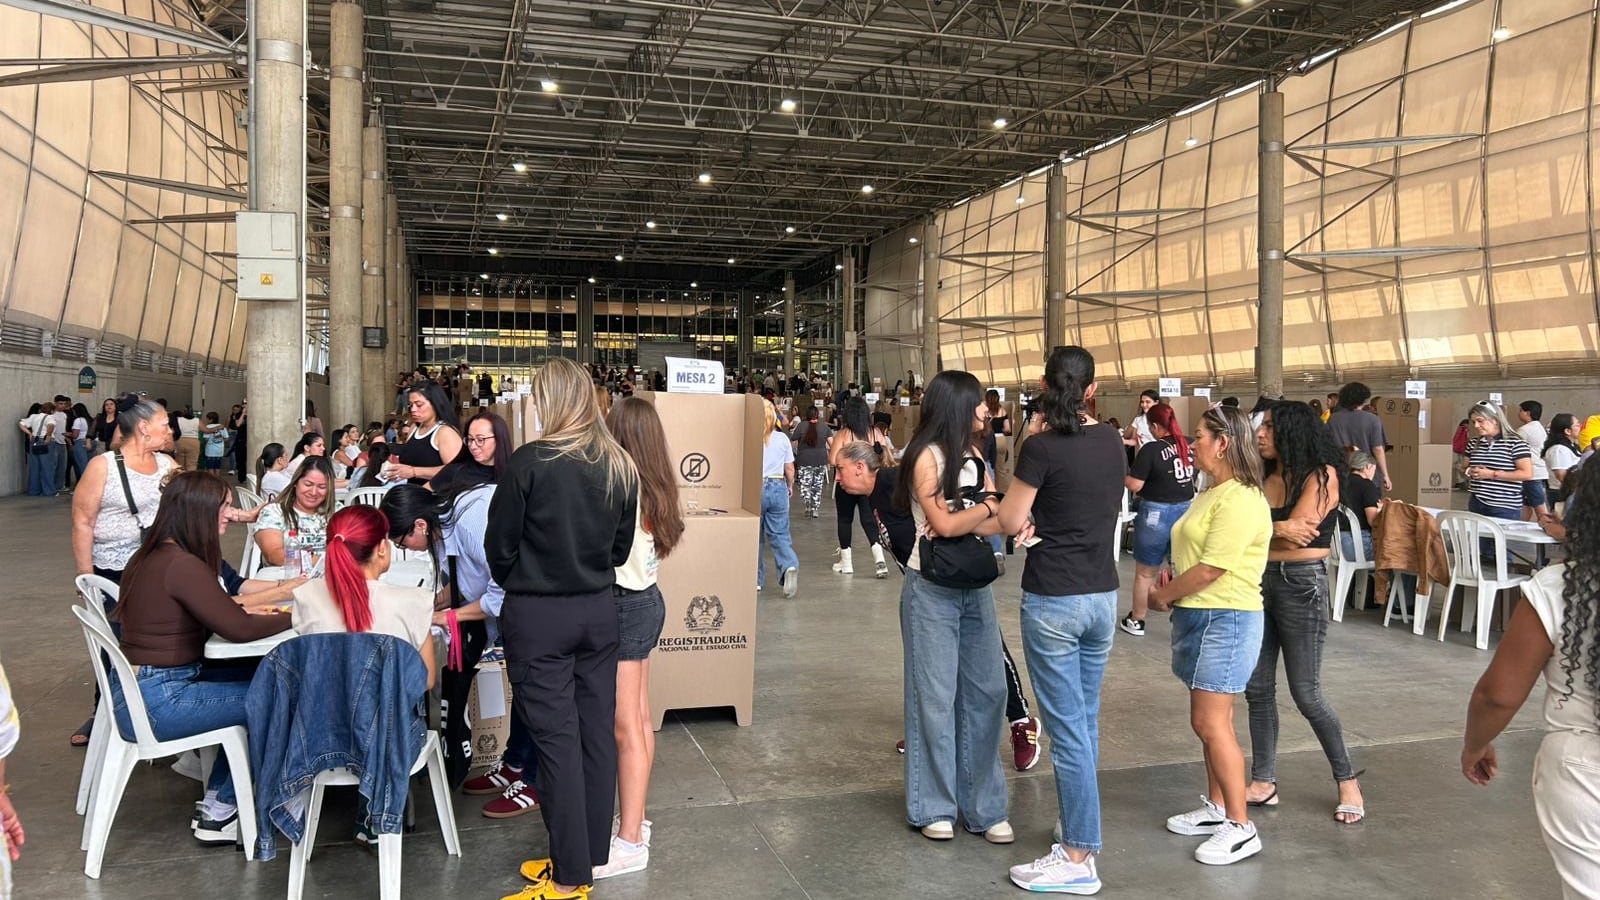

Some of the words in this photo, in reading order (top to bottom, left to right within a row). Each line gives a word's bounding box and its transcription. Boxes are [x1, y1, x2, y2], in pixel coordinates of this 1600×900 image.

[676, 371, 706, 384] MESA
[708, 373, 716, 384] 2
[659, 633, 747, 646] REGISTRADURÍA
